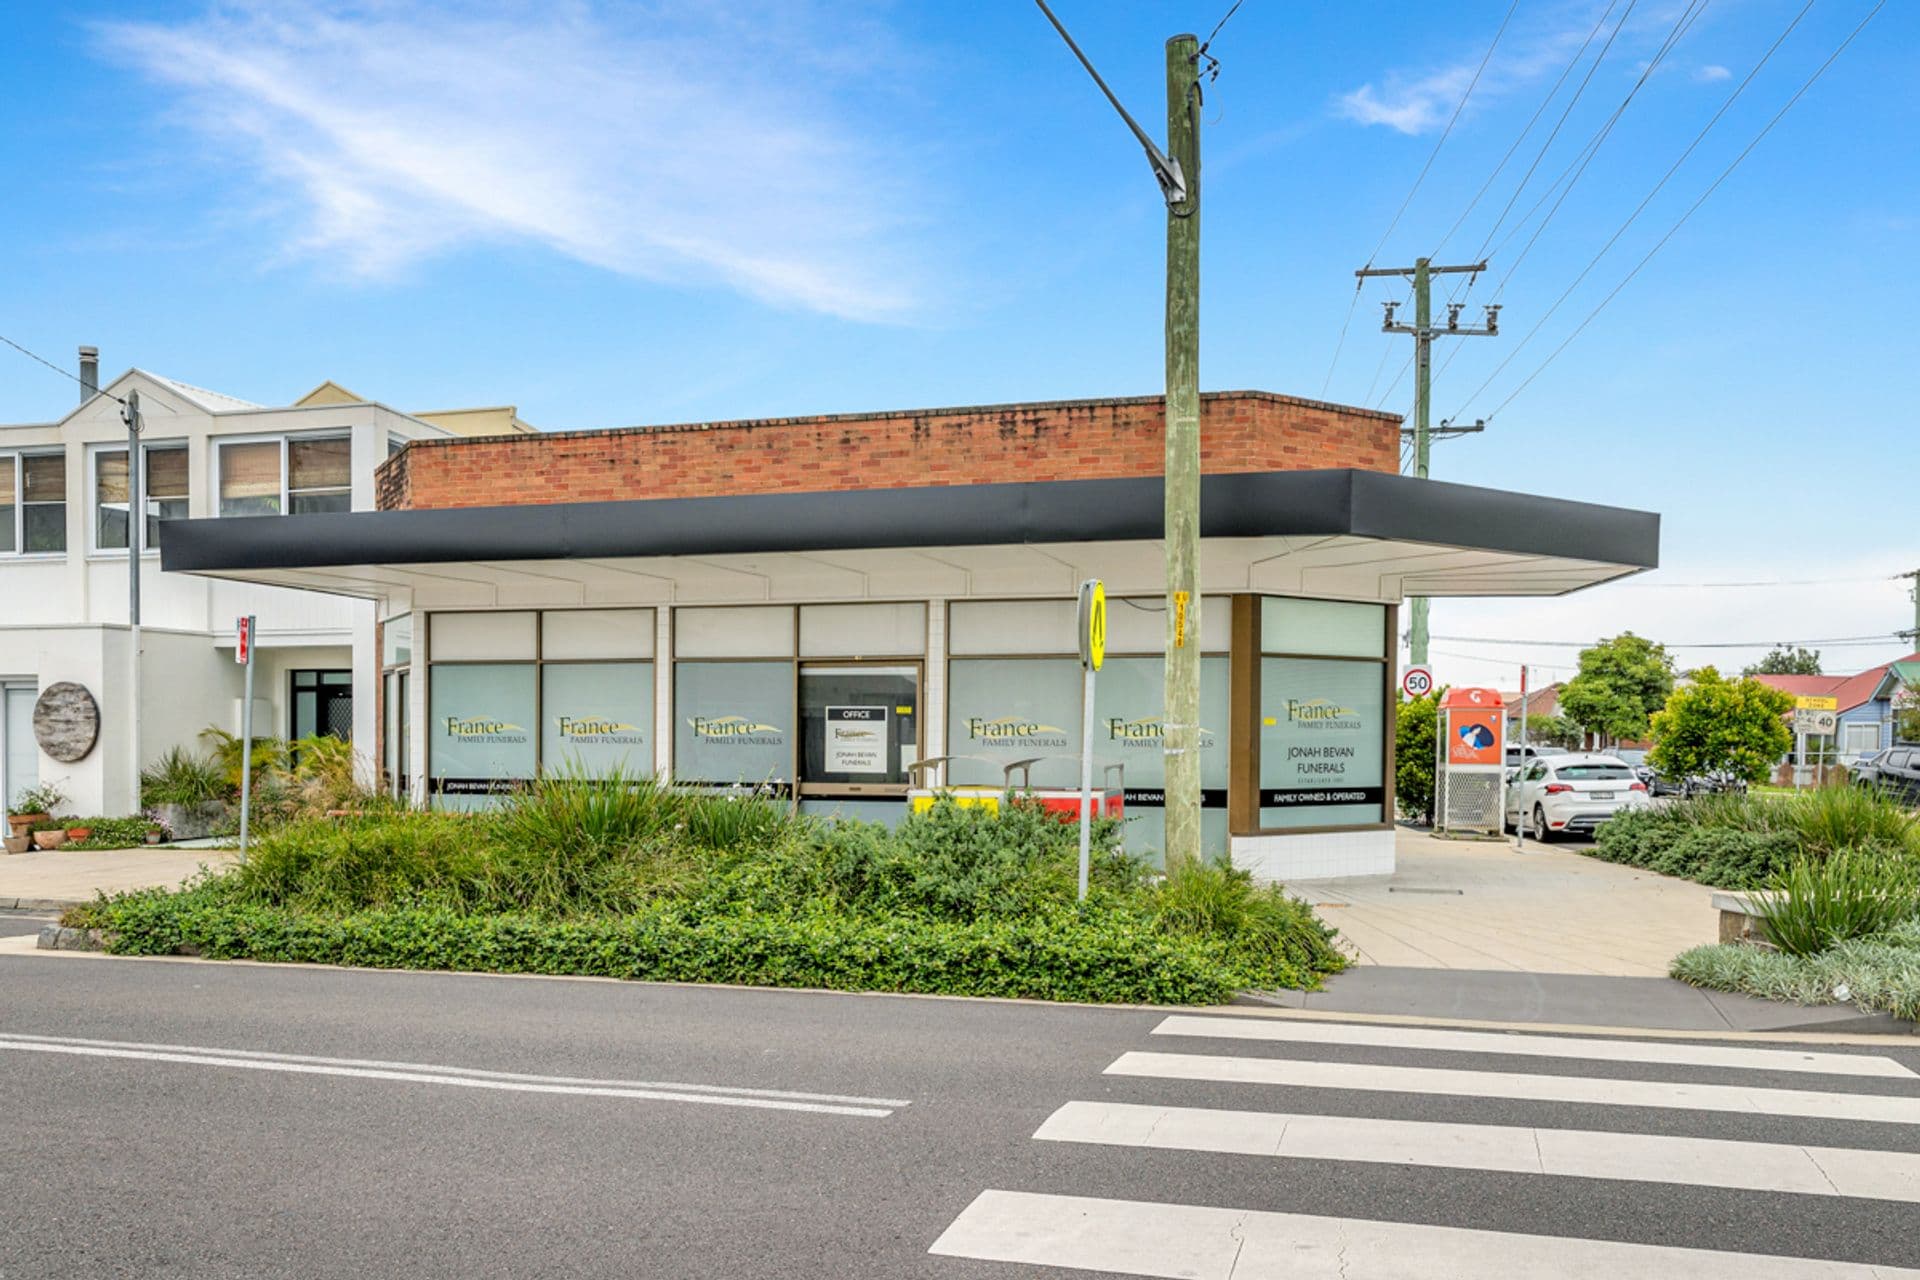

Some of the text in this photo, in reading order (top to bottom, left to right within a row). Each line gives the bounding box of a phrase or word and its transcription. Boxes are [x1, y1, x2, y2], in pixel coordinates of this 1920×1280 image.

[1408, 676, 1428, 690] 50
[842, 710, 871, 719] OFFICE
[1287, 699, 1341, 721] France
[447, 717, 504, 736] France
[559, 716, 619, 737] France
[694, 716, 757, 737] France
[1297, 721, 1361, 729] FAMILY FUNERALS
[1818, 716, 1833, 727] 40
[970, 718, 1039, 739] France
[486, 736, 527, 744] FUNERALS
[569, 736, 644, 744] FAMILY FUNERALS
[705, 736, 783, 745] FAMILY FUNERALS
[982, 739, 1067, 747] FAMILY FUNERALS
[1123, 740, 1159, 748] FAMILY
[1286, 747, 1355, 761] JONAH BEVAN
[1297, 762, 1345, 773] FUNERALS
[1274, 794, 1298, 803] FAMILY
[1298, 793, 1326, 802] OWNED
[1332, 792, 1367, 801] OPERATED
